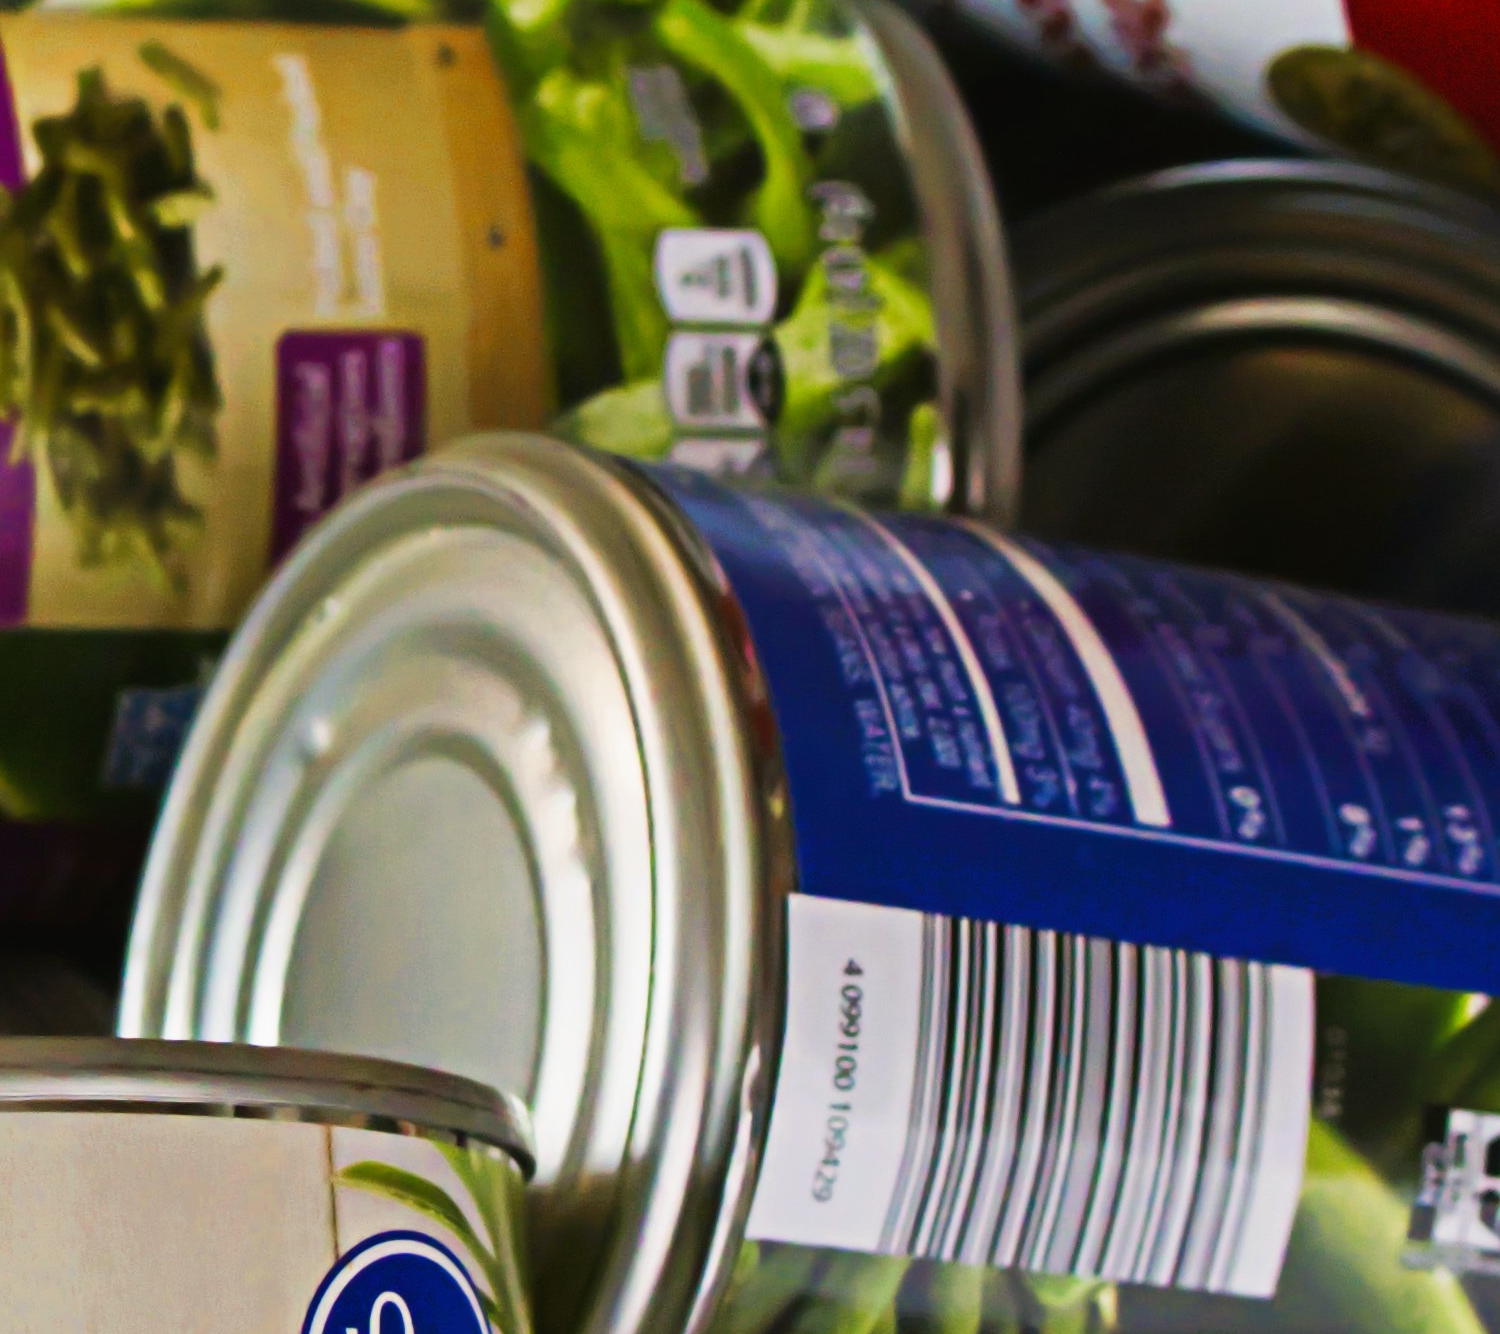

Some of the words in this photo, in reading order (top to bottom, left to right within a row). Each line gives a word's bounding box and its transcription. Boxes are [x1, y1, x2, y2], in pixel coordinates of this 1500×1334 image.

[842, 958, 865, 977] 4
[833, 983, 864, 1092] 099100
[811, 1101, 853, 1204] 109429
